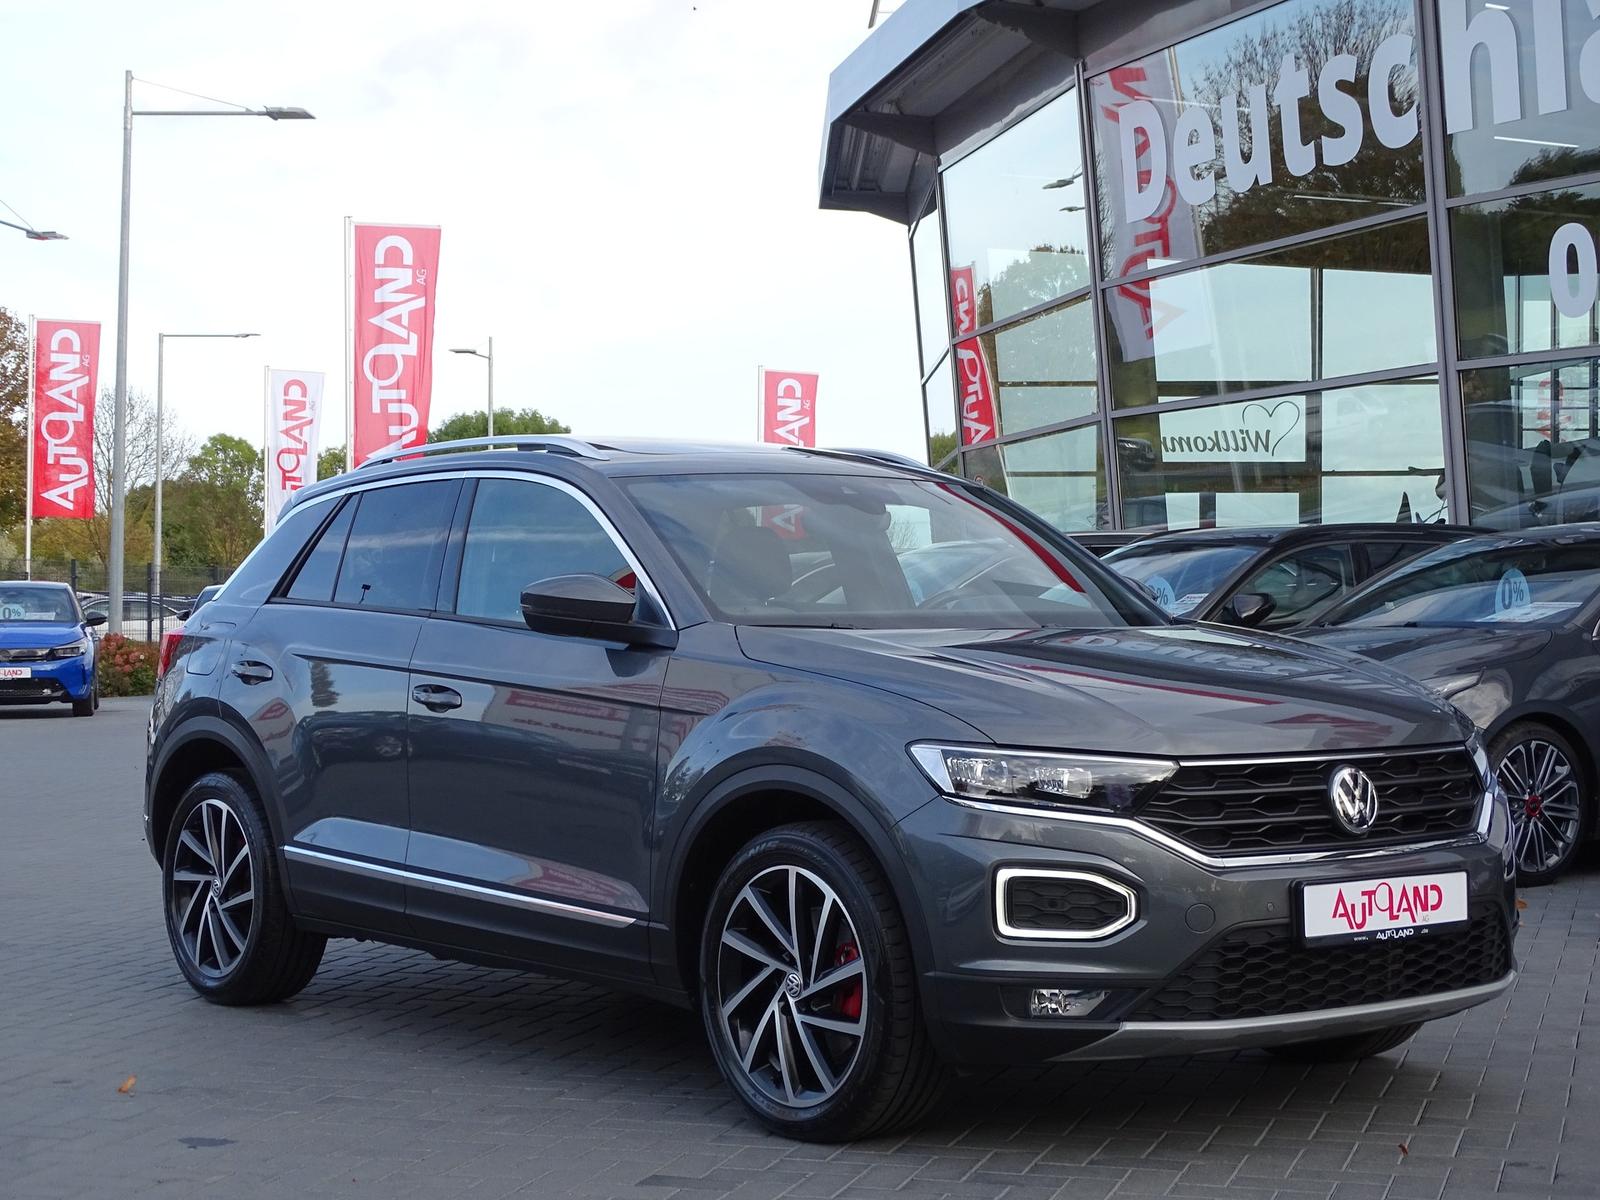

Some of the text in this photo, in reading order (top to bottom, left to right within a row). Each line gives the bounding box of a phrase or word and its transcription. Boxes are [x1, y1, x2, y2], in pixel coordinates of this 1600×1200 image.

[1117, 0, 1600, 223] Deutschl
[416, 268, 427, 286] AG
[82, 354, 91, 368] AG
[40, 328, 90, 511] AUTOLAND
[276, 379, 314, 491] TOLAND
[1502, 578, 1525, 610] 0%
[2, 607, 21, 620] 0%
[0, 669, 23, 677] LAND
[1332, 882, 1443, 930] AUTOLAND
[1376, 928, 1414, 940] AUTOLAND
